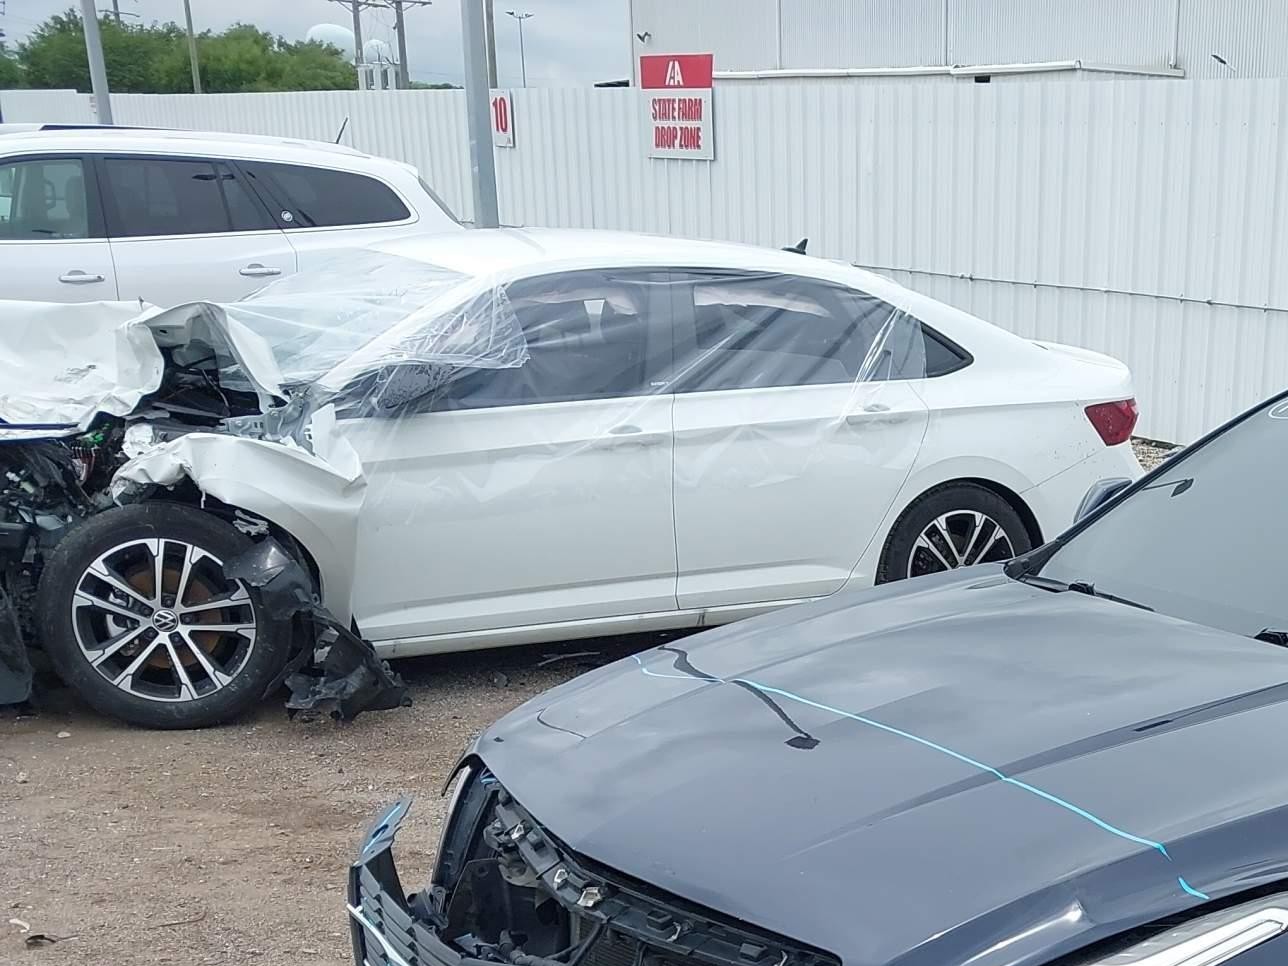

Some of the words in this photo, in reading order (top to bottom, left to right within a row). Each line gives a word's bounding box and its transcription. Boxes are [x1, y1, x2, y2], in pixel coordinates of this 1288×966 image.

[492, 96, 508, 132] 10
[651, 98, 677, 121] STATE
[678, 98, 703, 121] FARM
[654, 126, 678, 149] DROP
[679, 126, 702, 150] ZONE
